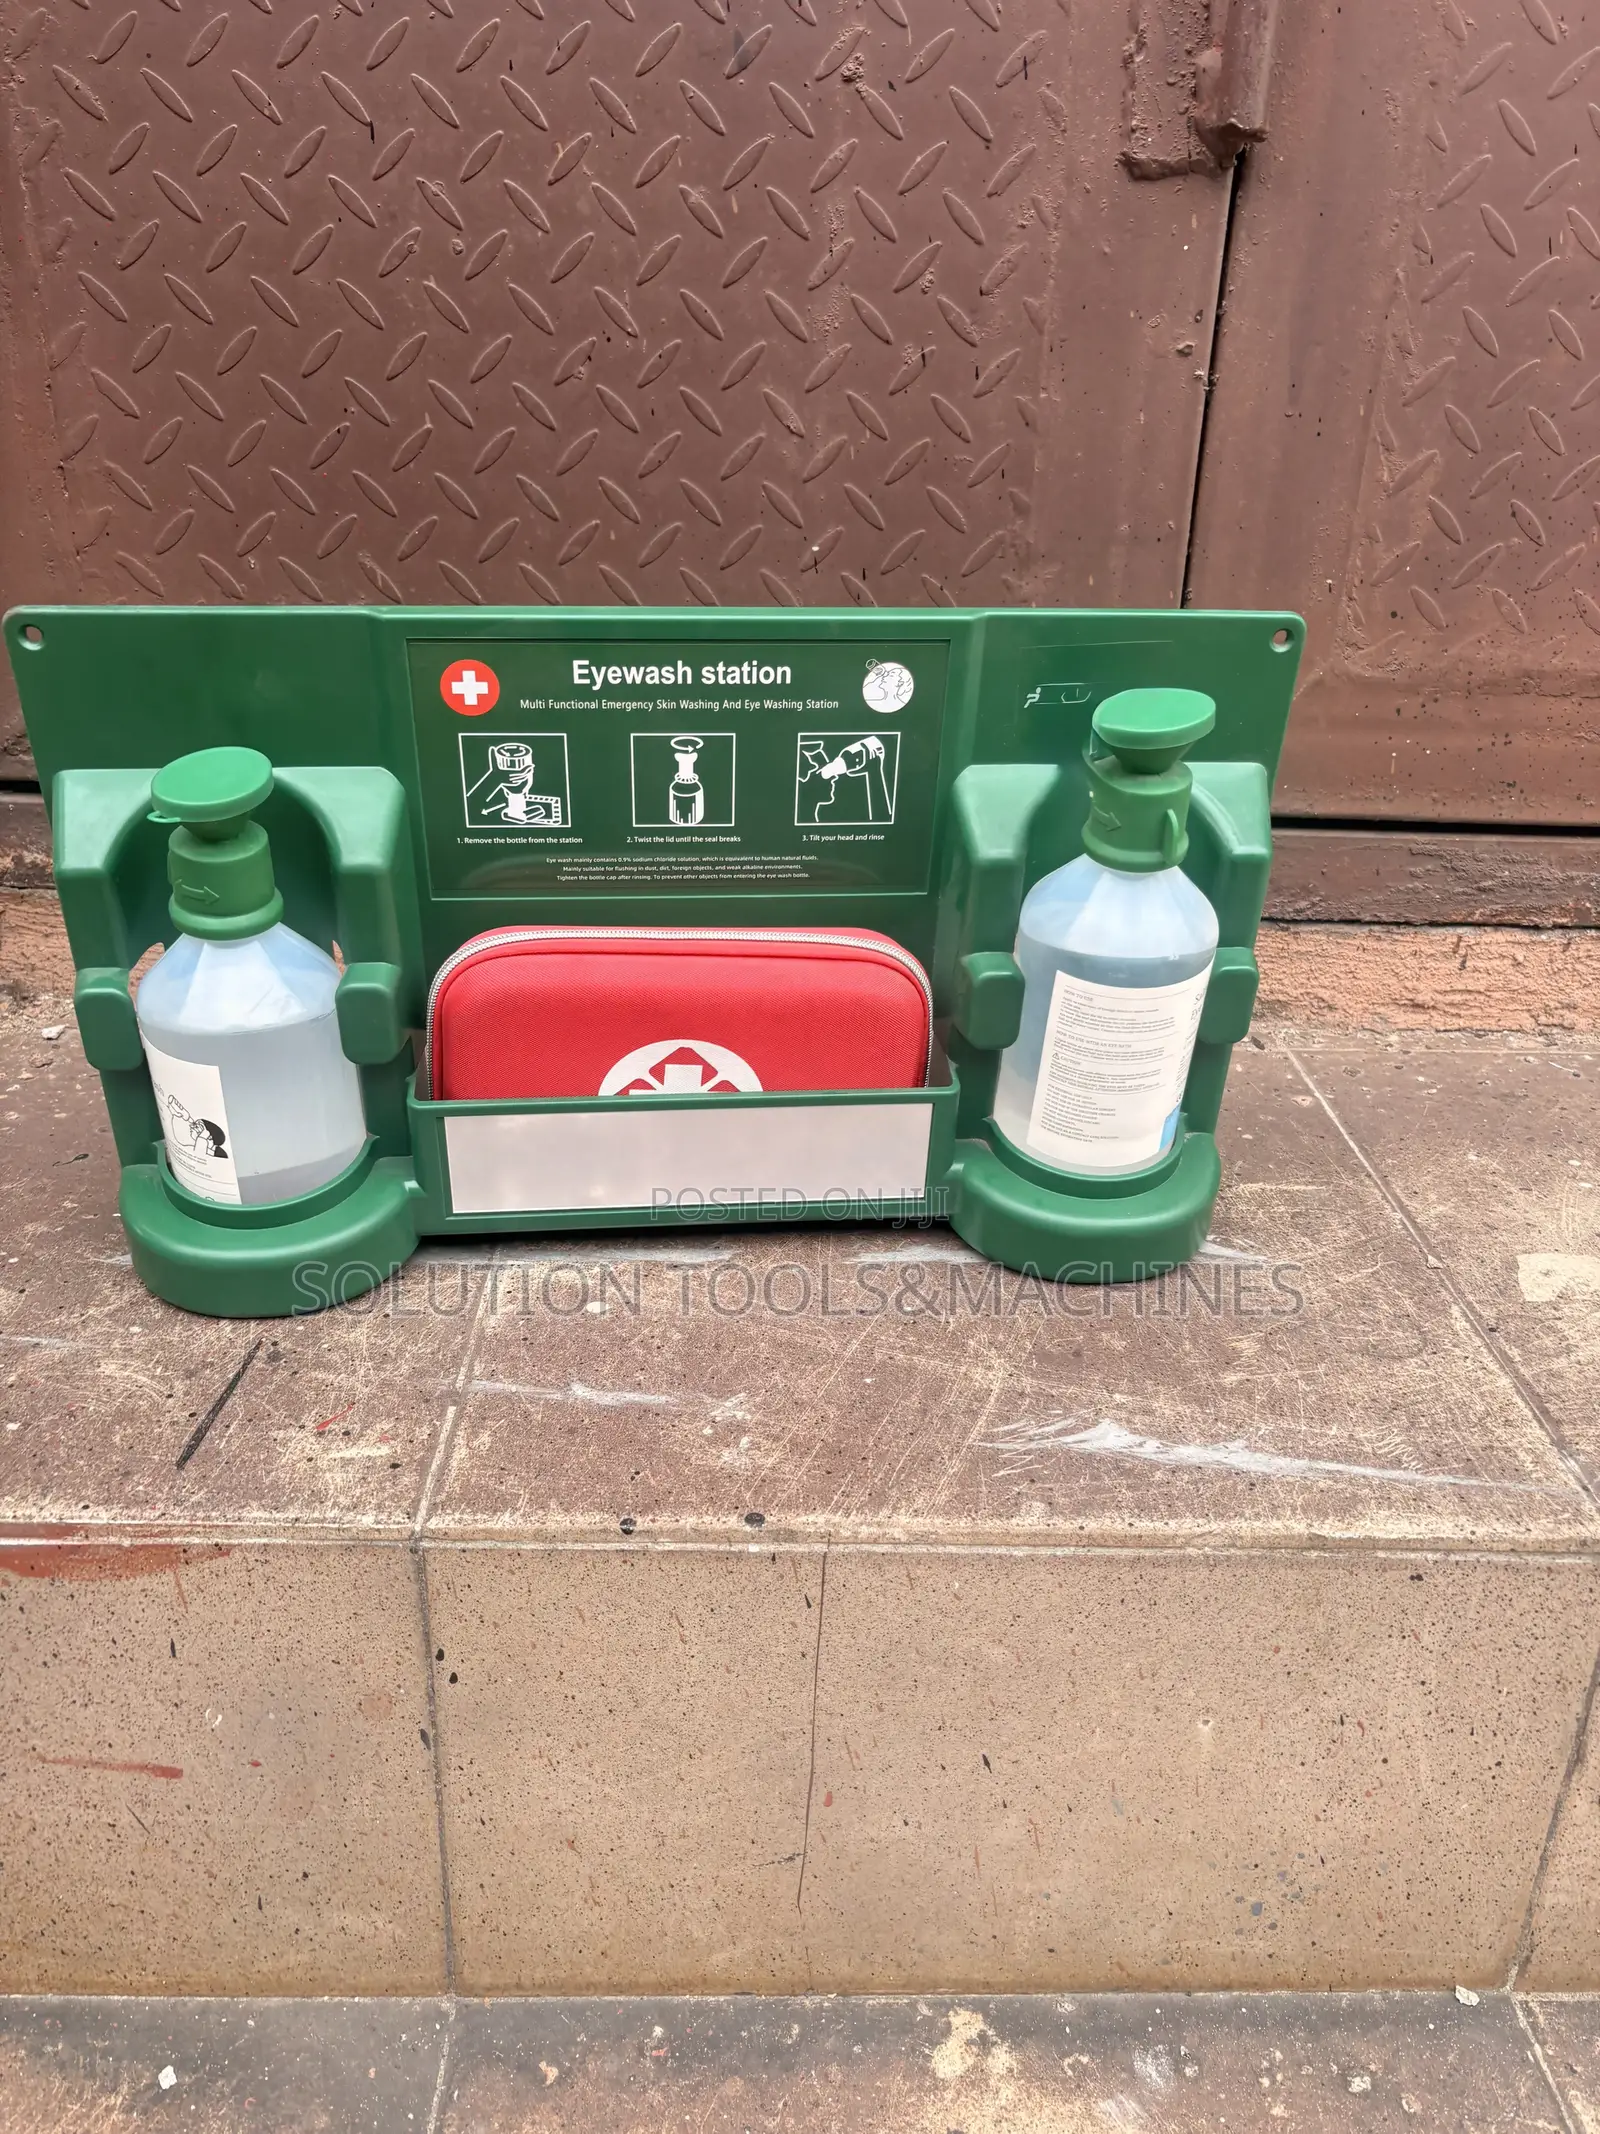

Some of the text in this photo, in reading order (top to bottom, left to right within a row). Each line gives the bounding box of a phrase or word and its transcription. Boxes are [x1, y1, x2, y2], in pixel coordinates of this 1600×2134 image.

[572, 659, 791, 691] Eyewash station
[520, 699, 839, 712] Multi Functional Emergency Skin Washing And Eye Washing Station
[559, 836, 583, 844] station
[802, 834, 809, 842] 3.
[821, 835, 836, 843] your
[837, 833, 854, 841] head
